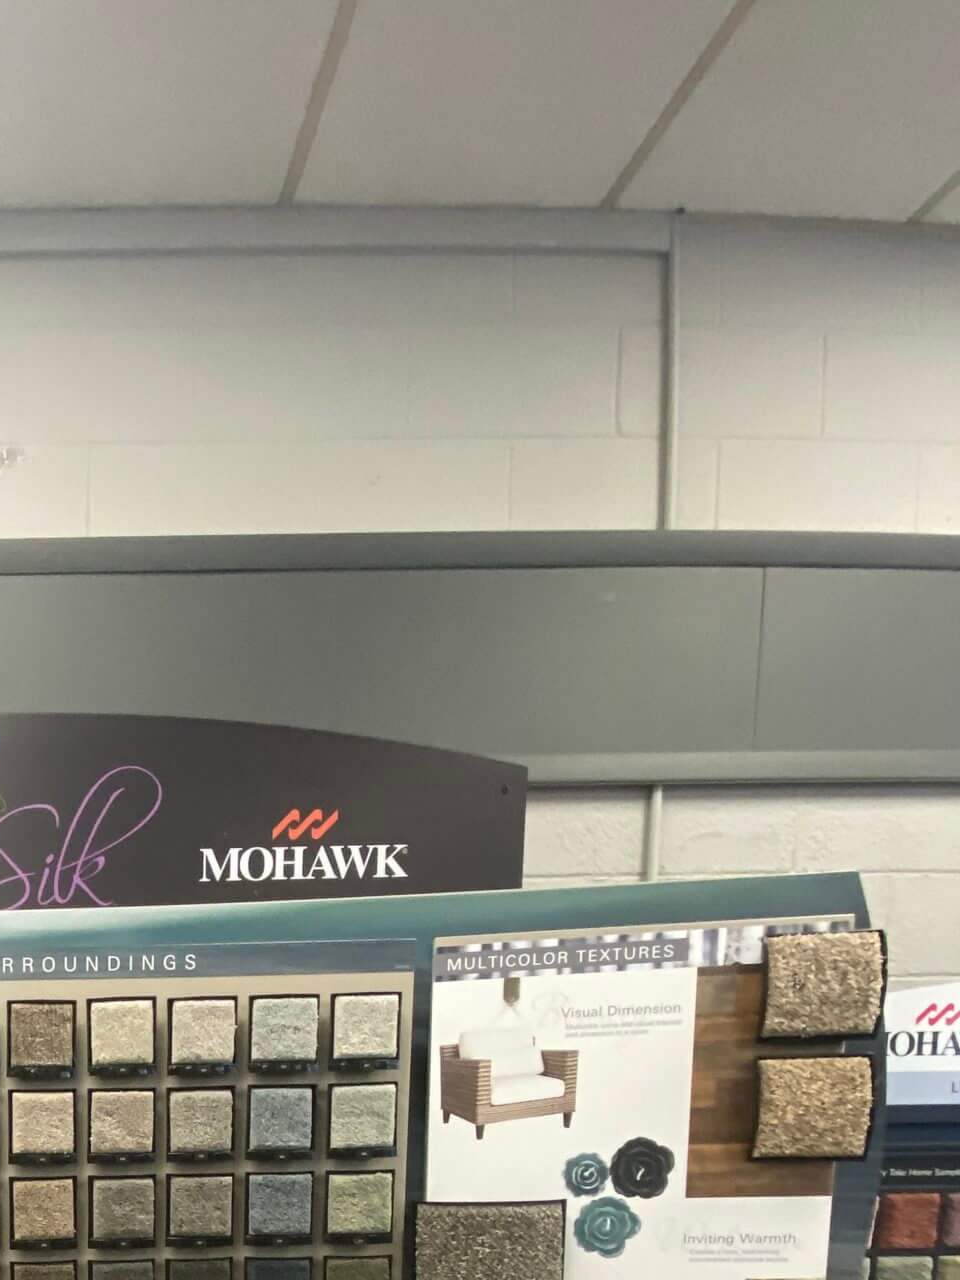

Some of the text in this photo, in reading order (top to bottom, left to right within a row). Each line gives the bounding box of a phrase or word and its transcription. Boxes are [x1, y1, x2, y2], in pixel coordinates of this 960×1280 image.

[199, 843, 409, 883] MOHAWK
[447, 944, 675, 972] MULTICOLOR TEXTURES
[560, 1003, 681, 1018] Visual Dimension
[886, 1030, 960, 1057] OHA
[683, 1233, 797, 1247] Inviting Warmth
